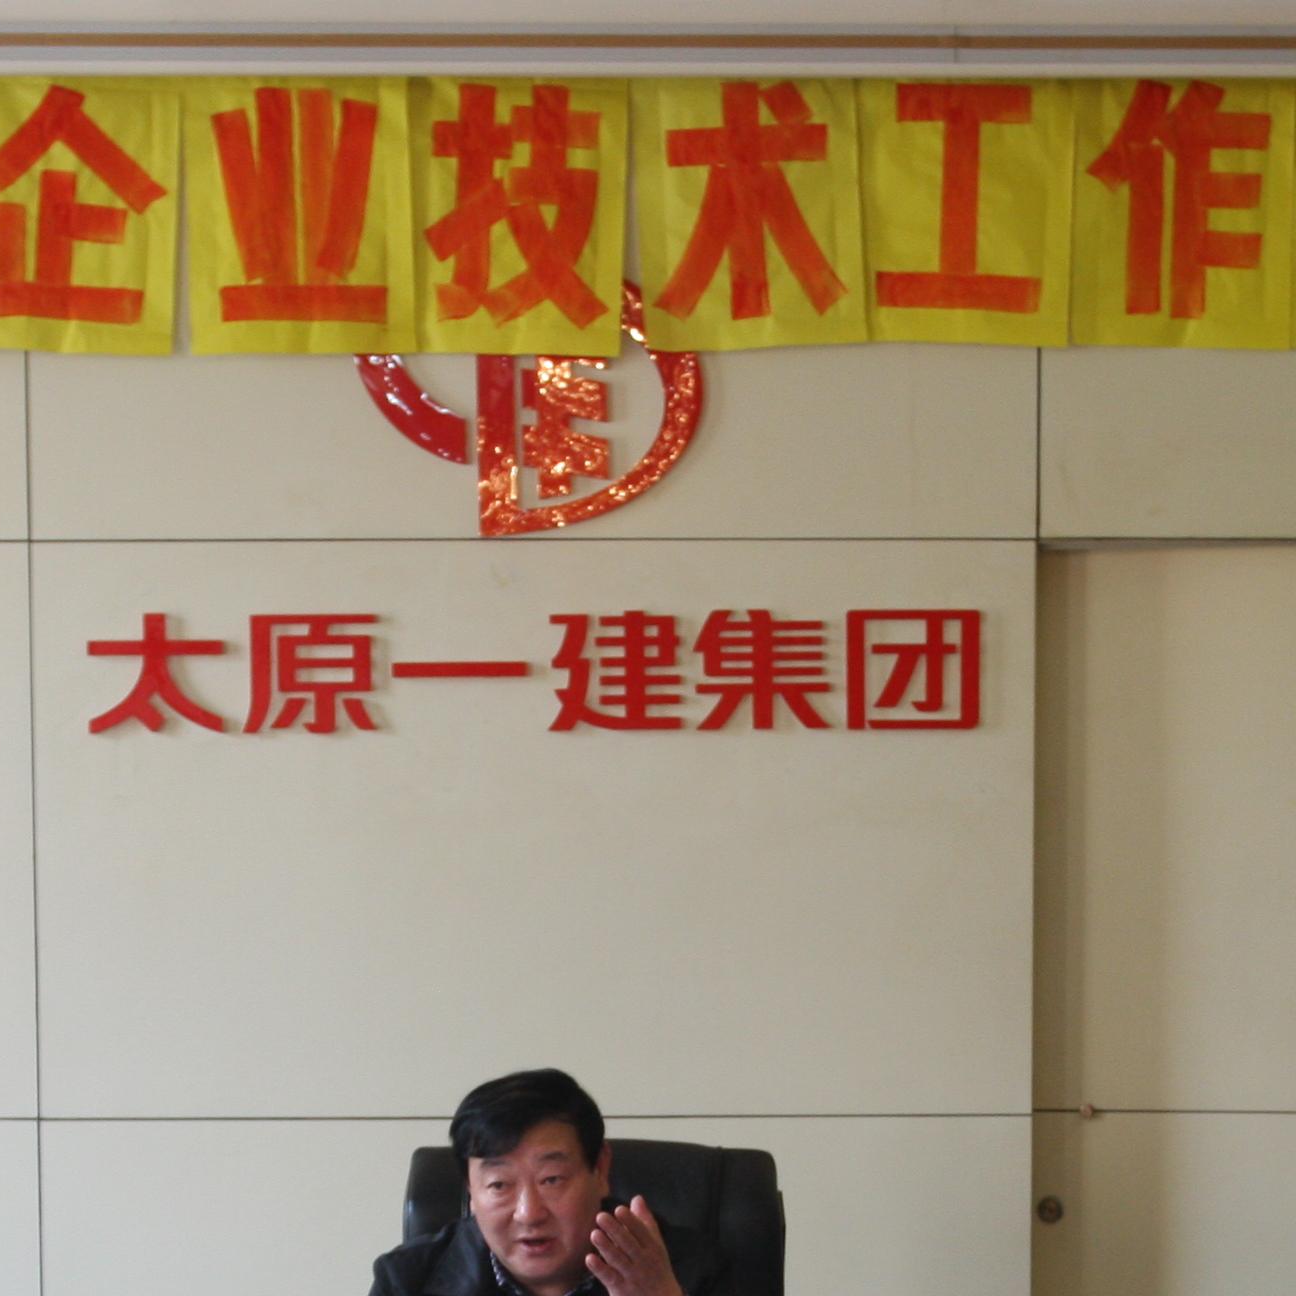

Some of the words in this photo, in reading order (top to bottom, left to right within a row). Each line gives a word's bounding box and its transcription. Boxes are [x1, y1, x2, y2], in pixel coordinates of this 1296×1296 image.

[87, 608, 982, 735] 太原一建集团
